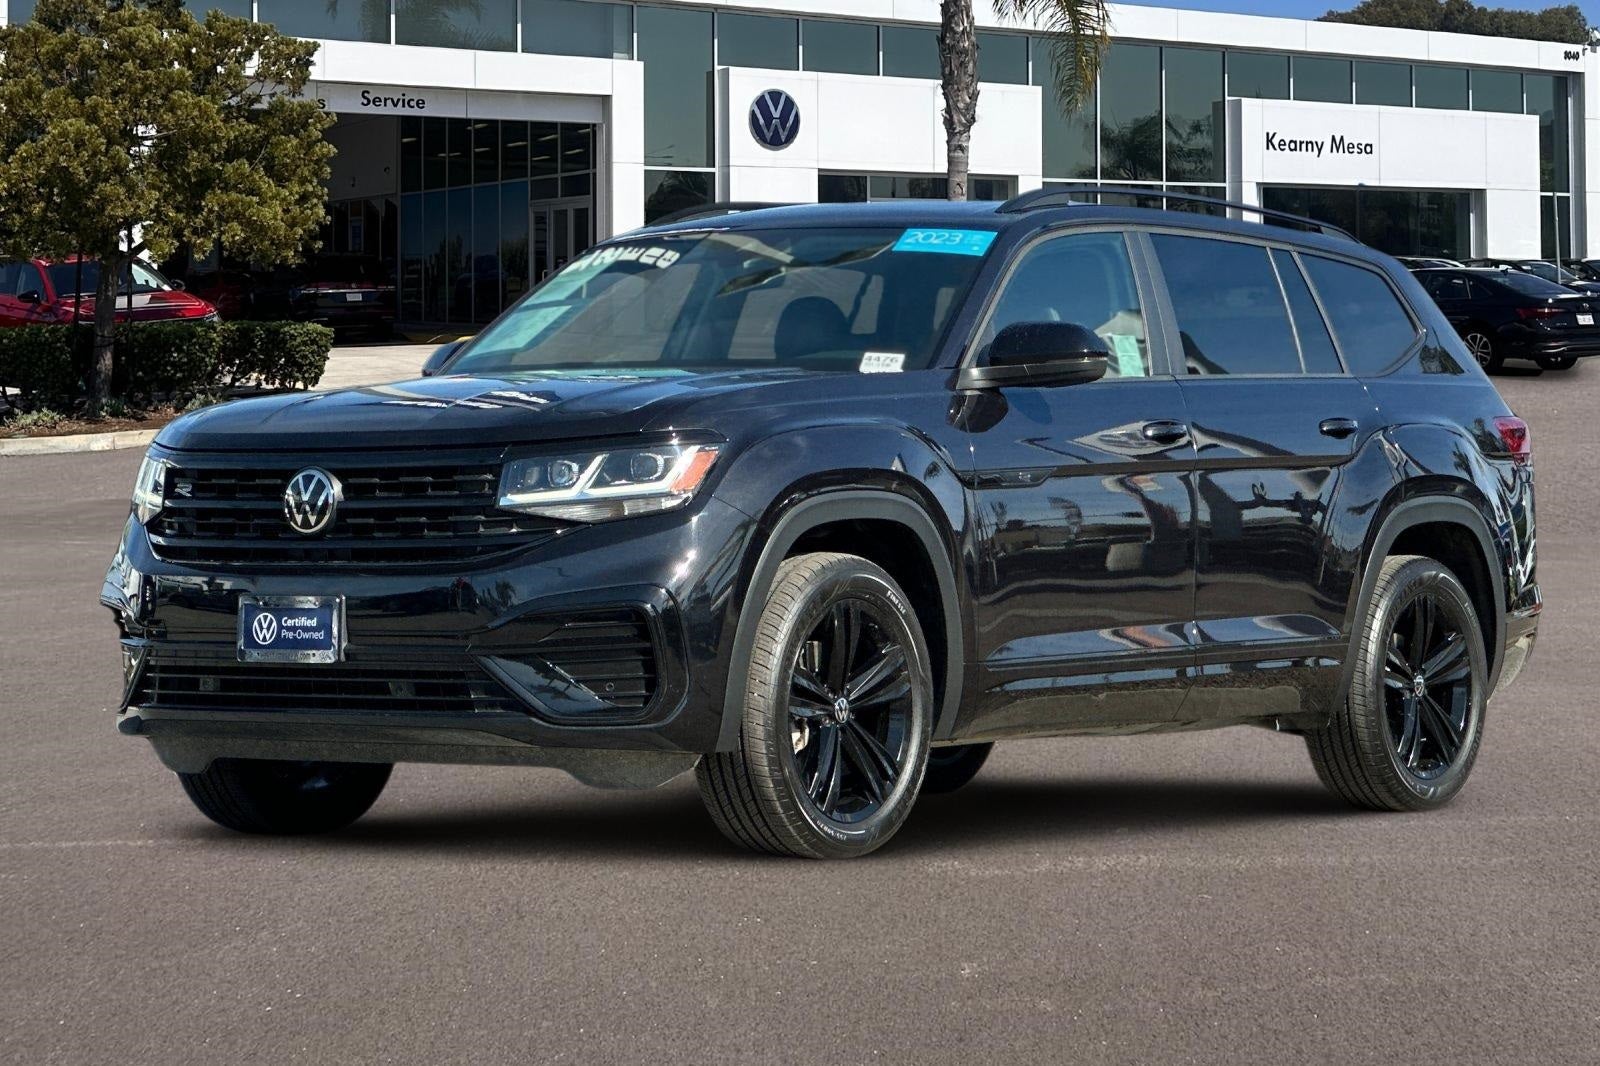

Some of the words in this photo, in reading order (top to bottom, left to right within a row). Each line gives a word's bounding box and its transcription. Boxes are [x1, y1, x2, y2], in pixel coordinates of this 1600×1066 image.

[360, 89, 426, 110] Service
[749, 89, 800, 151] VW
[1265, 131, 1324, 158] Kearny
[1330, 134, 1373, 155] Mesa
[904, 231, 963, 245] 2023
[252, 612, 278, 645] VW
[281, 616, 317, 627] Certified
[281, 629, 324, 640] Pre-Owned
